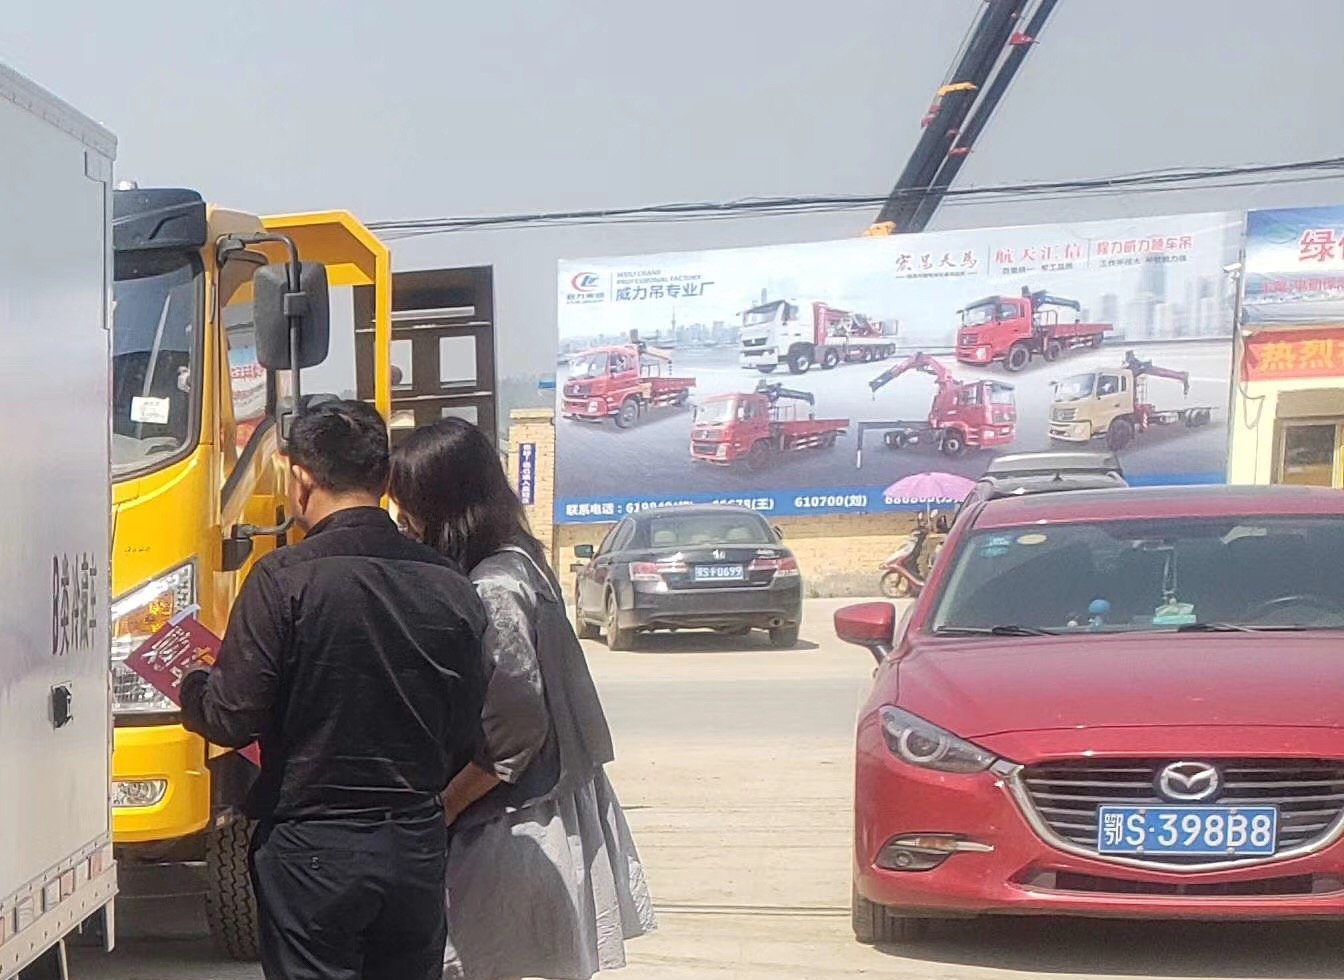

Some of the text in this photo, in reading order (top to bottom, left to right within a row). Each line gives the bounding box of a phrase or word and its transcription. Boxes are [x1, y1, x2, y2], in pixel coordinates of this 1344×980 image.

[615, 282, 715, 302] 威力吊专业厂
[794, 494, 868, 508] 610700(刘)
[52, 552, 97, 656] B类冷藏车
[1103, 812, 1272, 848] 鄂S·398B8
